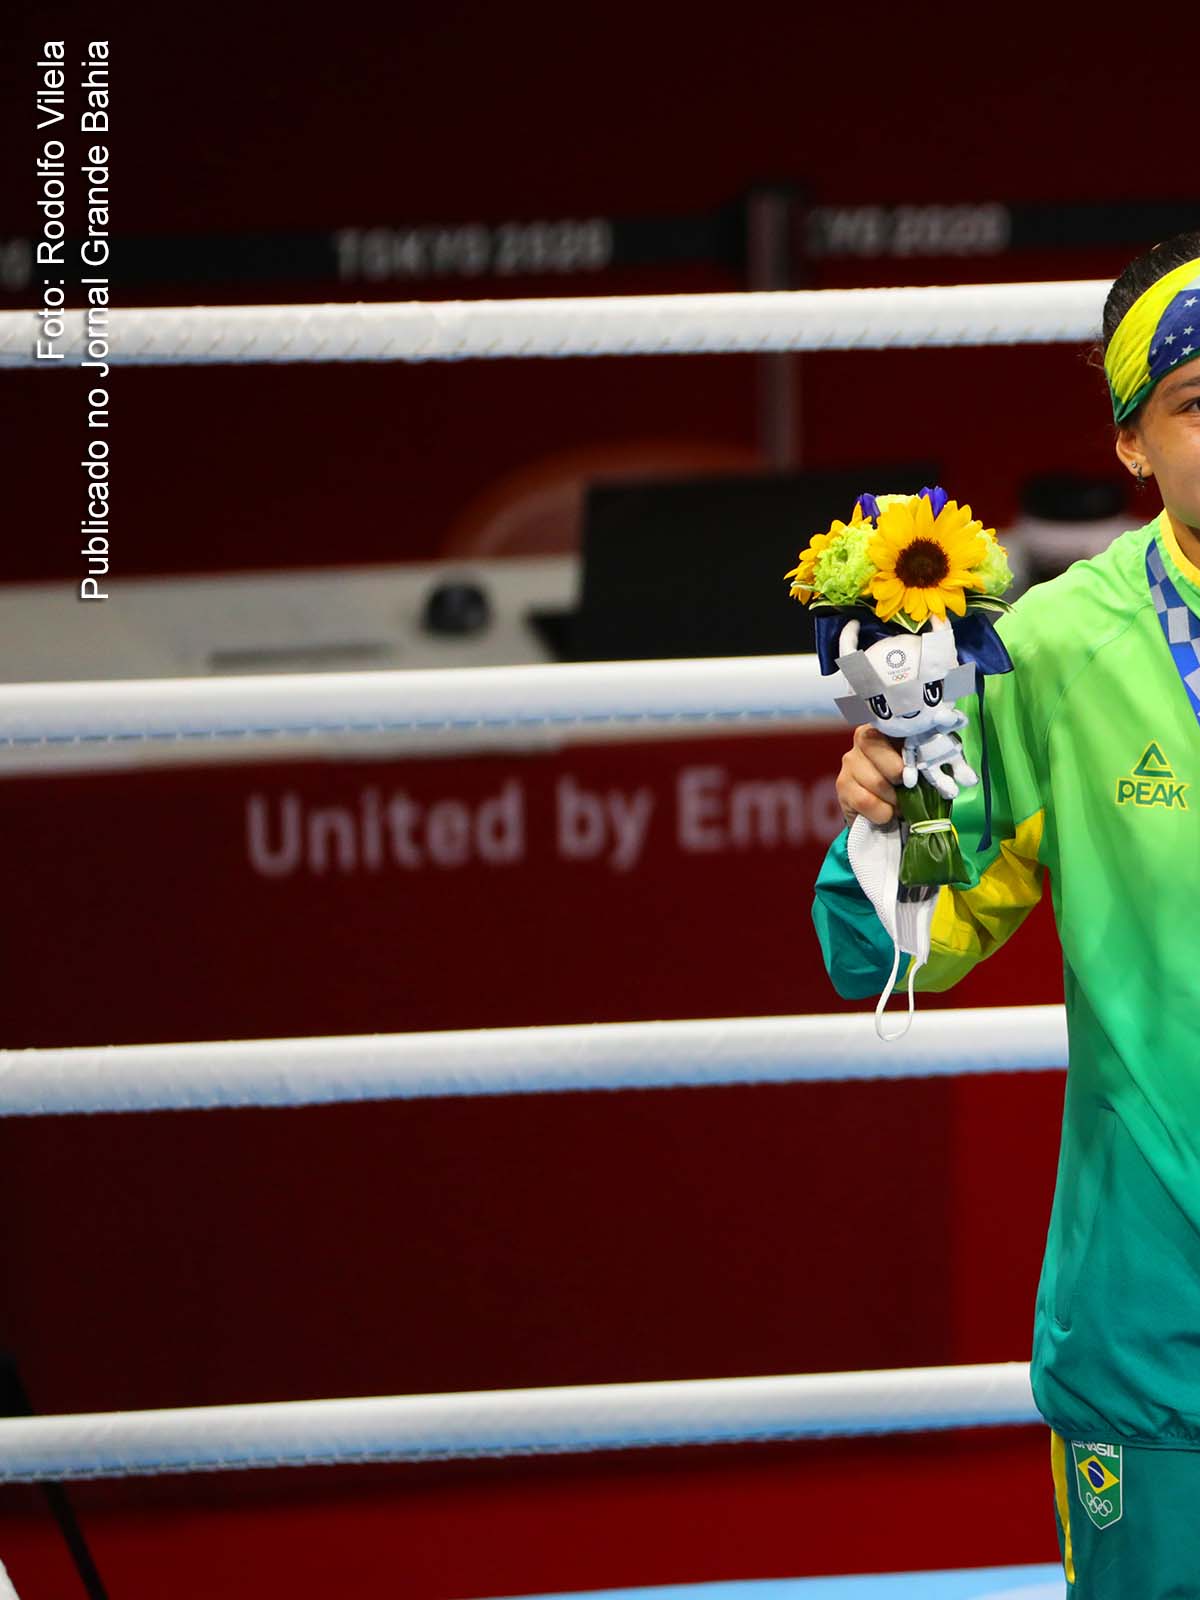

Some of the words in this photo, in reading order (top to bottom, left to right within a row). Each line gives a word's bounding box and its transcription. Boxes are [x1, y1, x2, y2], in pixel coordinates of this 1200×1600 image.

[247, 778, 525, 878] United
[556, 774, 653, 873] by
[1115, 778, 1188, 810] PEAK
